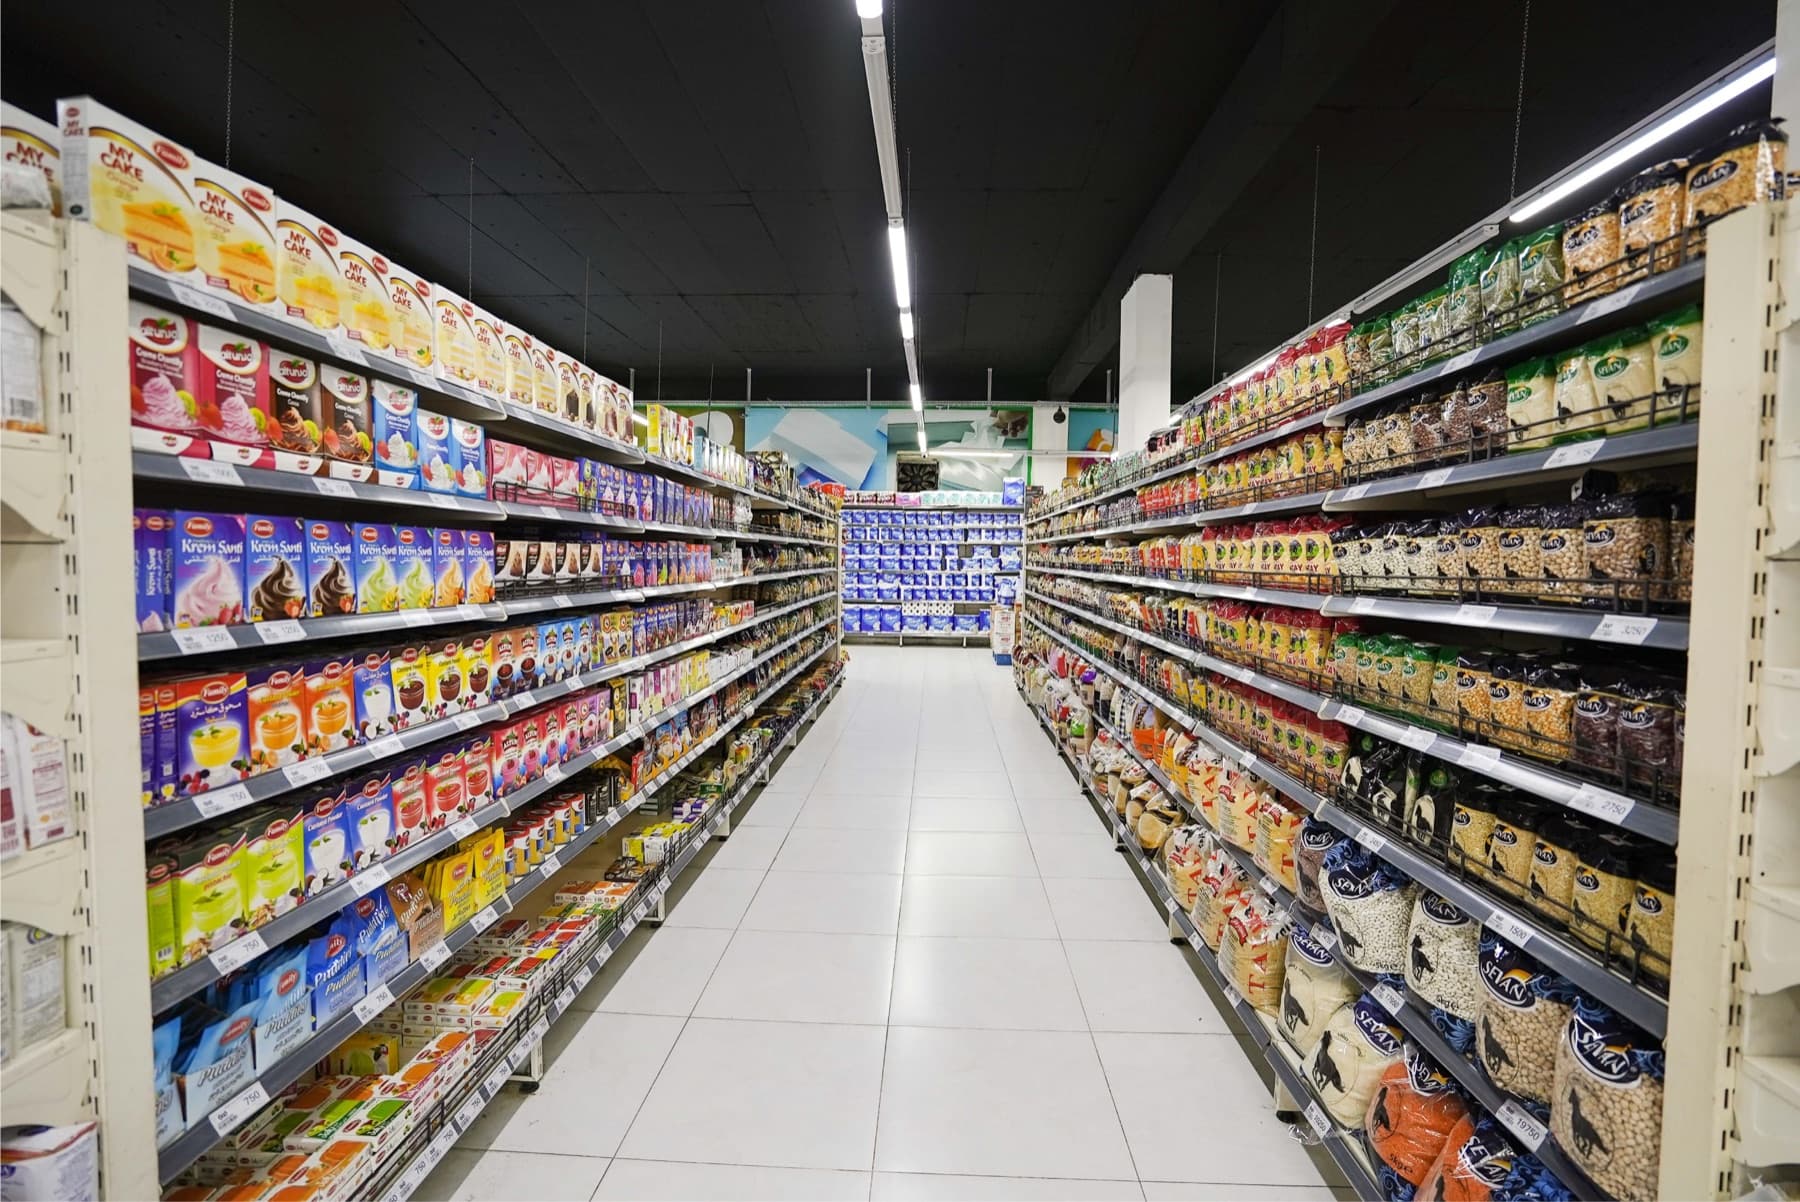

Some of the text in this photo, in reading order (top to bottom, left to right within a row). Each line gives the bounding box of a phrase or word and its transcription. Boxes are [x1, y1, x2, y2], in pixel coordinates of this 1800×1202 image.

[16, 141, 44, 164] MY
[109, 142, 133, 161] MY
[100, 152, 144, 183] CAKE
[205, 191, 226, 208] MY
[199, 201, 235, 225] CAKE
[289, 230, 306, 245] MY
[283, 240, 312, 260] CAKE
[349, 261, 363, 274] MY
[344, 270, 367, 287] CAKE
[395, 286, 408, 298] MY
[391, 294, 412, 310] CAKE
[444, 307, 455, 318] MY
[441, 315, 457, 329] CAKE
[476, 334, 491, 346] CAKE
[181, 538, 216, 553] Krem
[250, 540, 278, 553] Krem
[310, 542, 334, 554] Krem
[360, 544, 381, 555] Krem
[398, 545, 417, 555] Krem
[438, 546, 453, 556] Krem
[468, 547, 483, 556] Krem
[270, 676, 292, 686] Family
[202, 686, 229, 698] Family
[1601, 800, 1626, 817] 2750
[267, 822, 288, 836] Family
[208, 849, 231, 863] Family
[1508, 924, 1528, 940] 1500
[1482, 960, 1524, 1001] SEVAN
[1356, 1010, 1400, 1053] SEVAN
[244, 1090, 260, 1106] 750
[471, 1098, 481, 1109] 750
[443, 1129, 454, 1142] 750
[1516, 1117, 1541, 1142] 19750
[414, 1161, 426, 1175] 750
